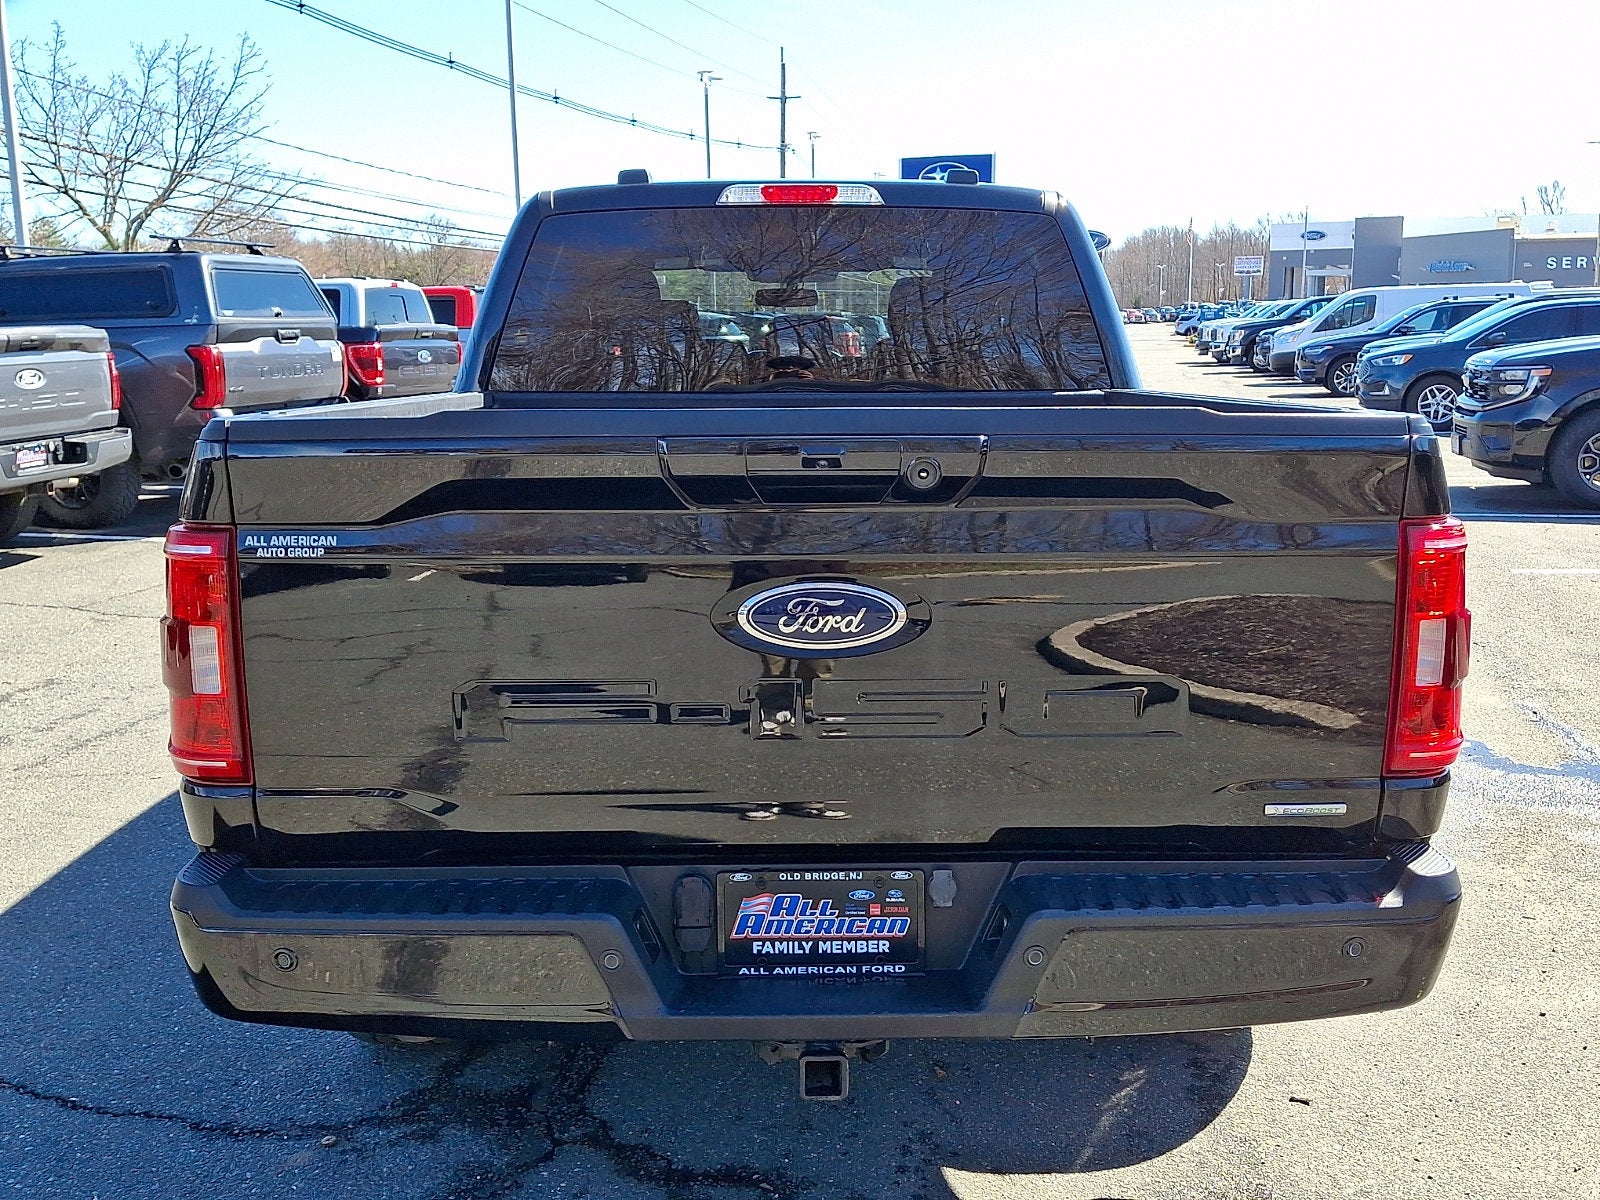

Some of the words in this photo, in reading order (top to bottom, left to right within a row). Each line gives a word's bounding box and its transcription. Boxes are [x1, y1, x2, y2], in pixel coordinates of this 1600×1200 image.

[257, 363, 324, 380] TUNDRA
[245, 535, 267, 546] ALL
[269, 535, 337, 546] AMERICAN
[256, 548, 285, 558] AUTO
[287, 547, 325, 557] GROUP
[777, 597, 867, 634] Ford
[779, 872, 801, 881] OLD
[769, 893, 839, 918] ALL
[733, 911, 911, 938] AMERICAN
[752, 941, 812, 954] FAMILY
[818, 940, 890, 954] MEMBER
[738, 966, 769, 975] ALL
[772, 966, 857, 975] AMERICAN
[862, 965, 906, 974] FORD
